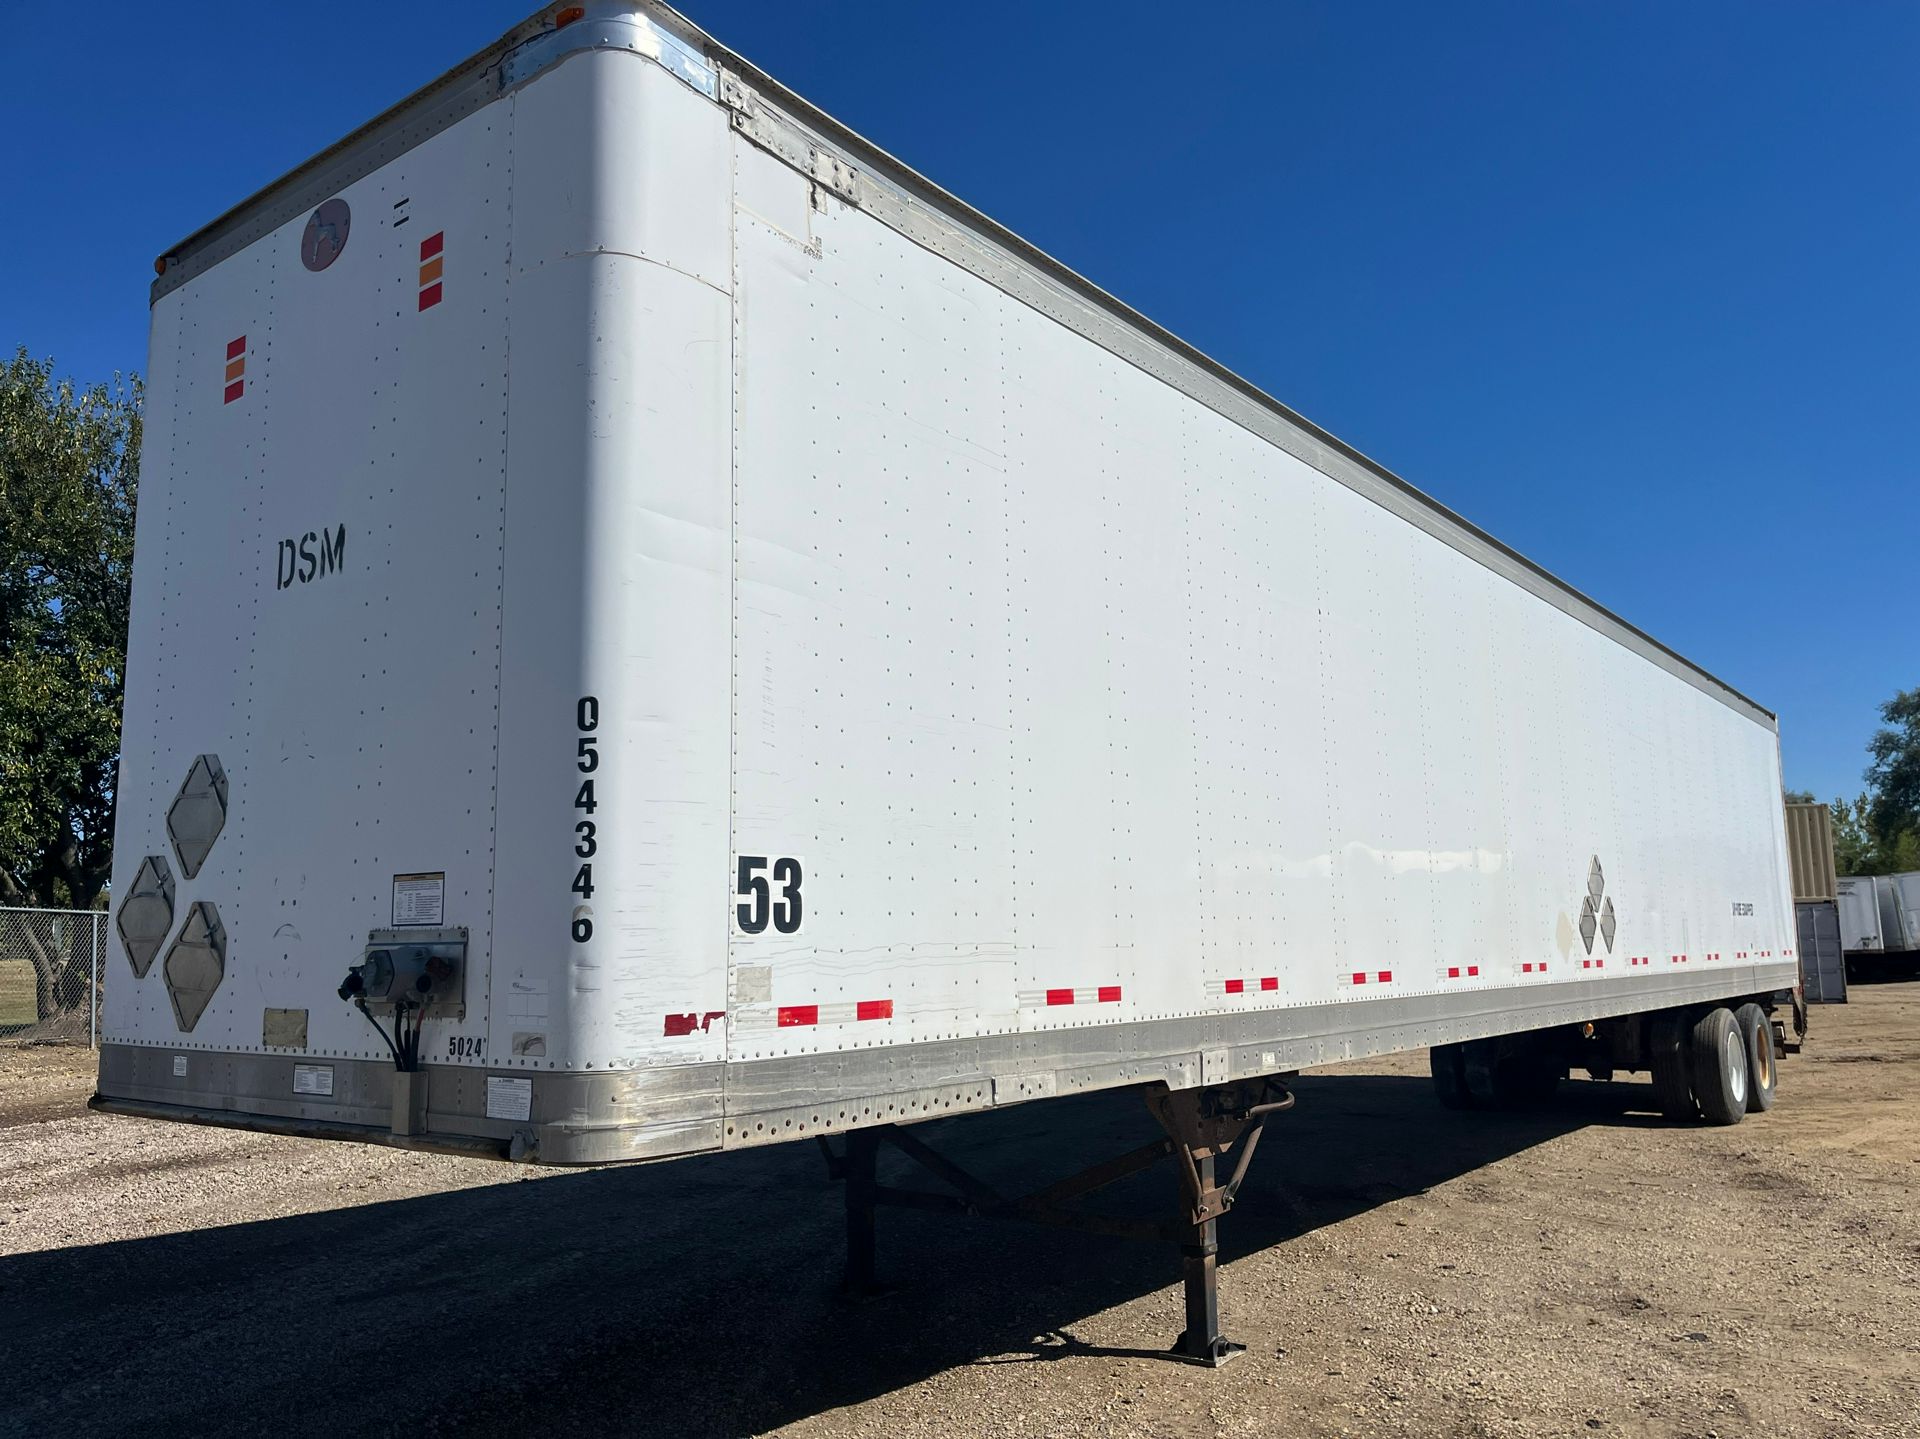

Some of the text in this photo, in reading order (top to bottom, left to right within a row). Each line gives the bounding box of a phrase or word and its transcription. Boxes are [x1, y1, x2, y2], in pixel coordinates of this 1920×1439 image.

[277, 523, 346, 591] DSM
[737, 856, 803, 934] 53
[449, 1036, 482, 1057] 5024
